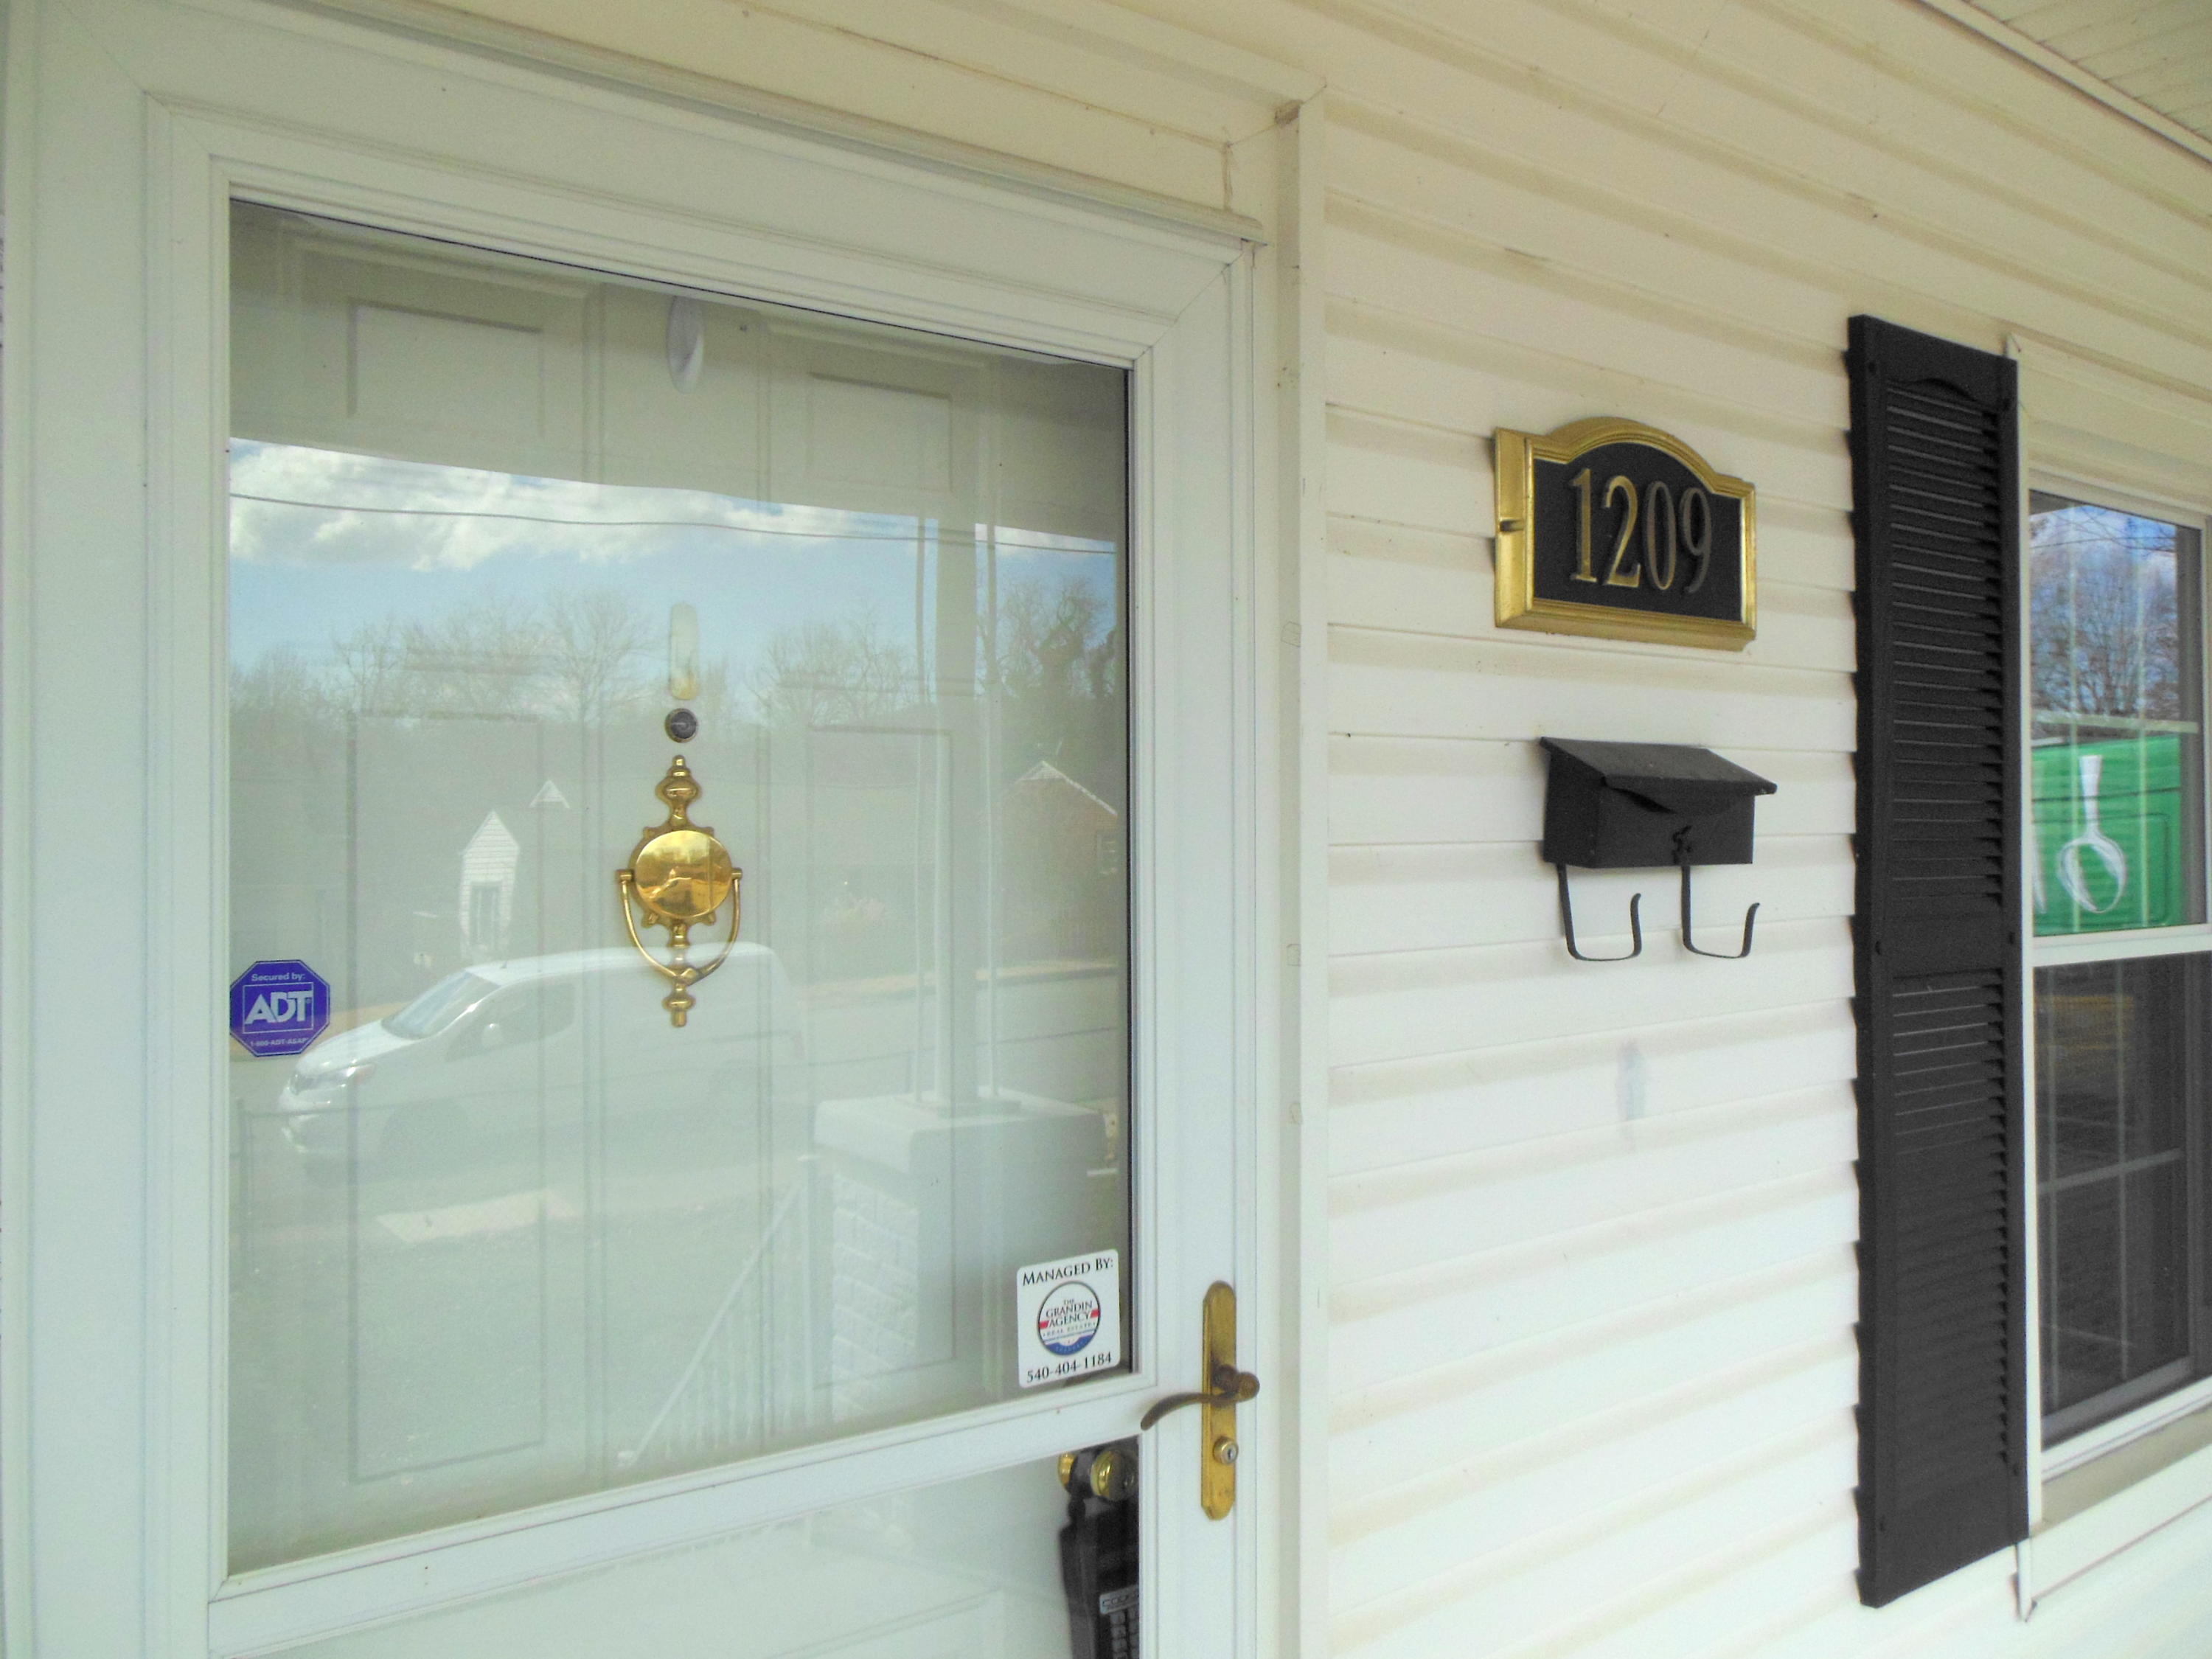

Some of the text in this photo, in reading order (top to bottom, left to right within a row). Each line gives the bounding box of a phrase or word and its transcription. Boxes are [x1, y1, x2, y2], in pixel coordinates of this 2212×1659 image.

[1570, 467, 1712, 594] 1209
[251, 972, 305, 982] Secured by:
[244, 990, 313, 1025] ADT
[1023, 1262, 1091, 1286] MANAGED
[1046, 1300, 1093, 1318] GRANDIN
[1048, 1312, 1091, 1328] AGENCY
[1026, 1351, 1112, 1383] 540-404-1184
